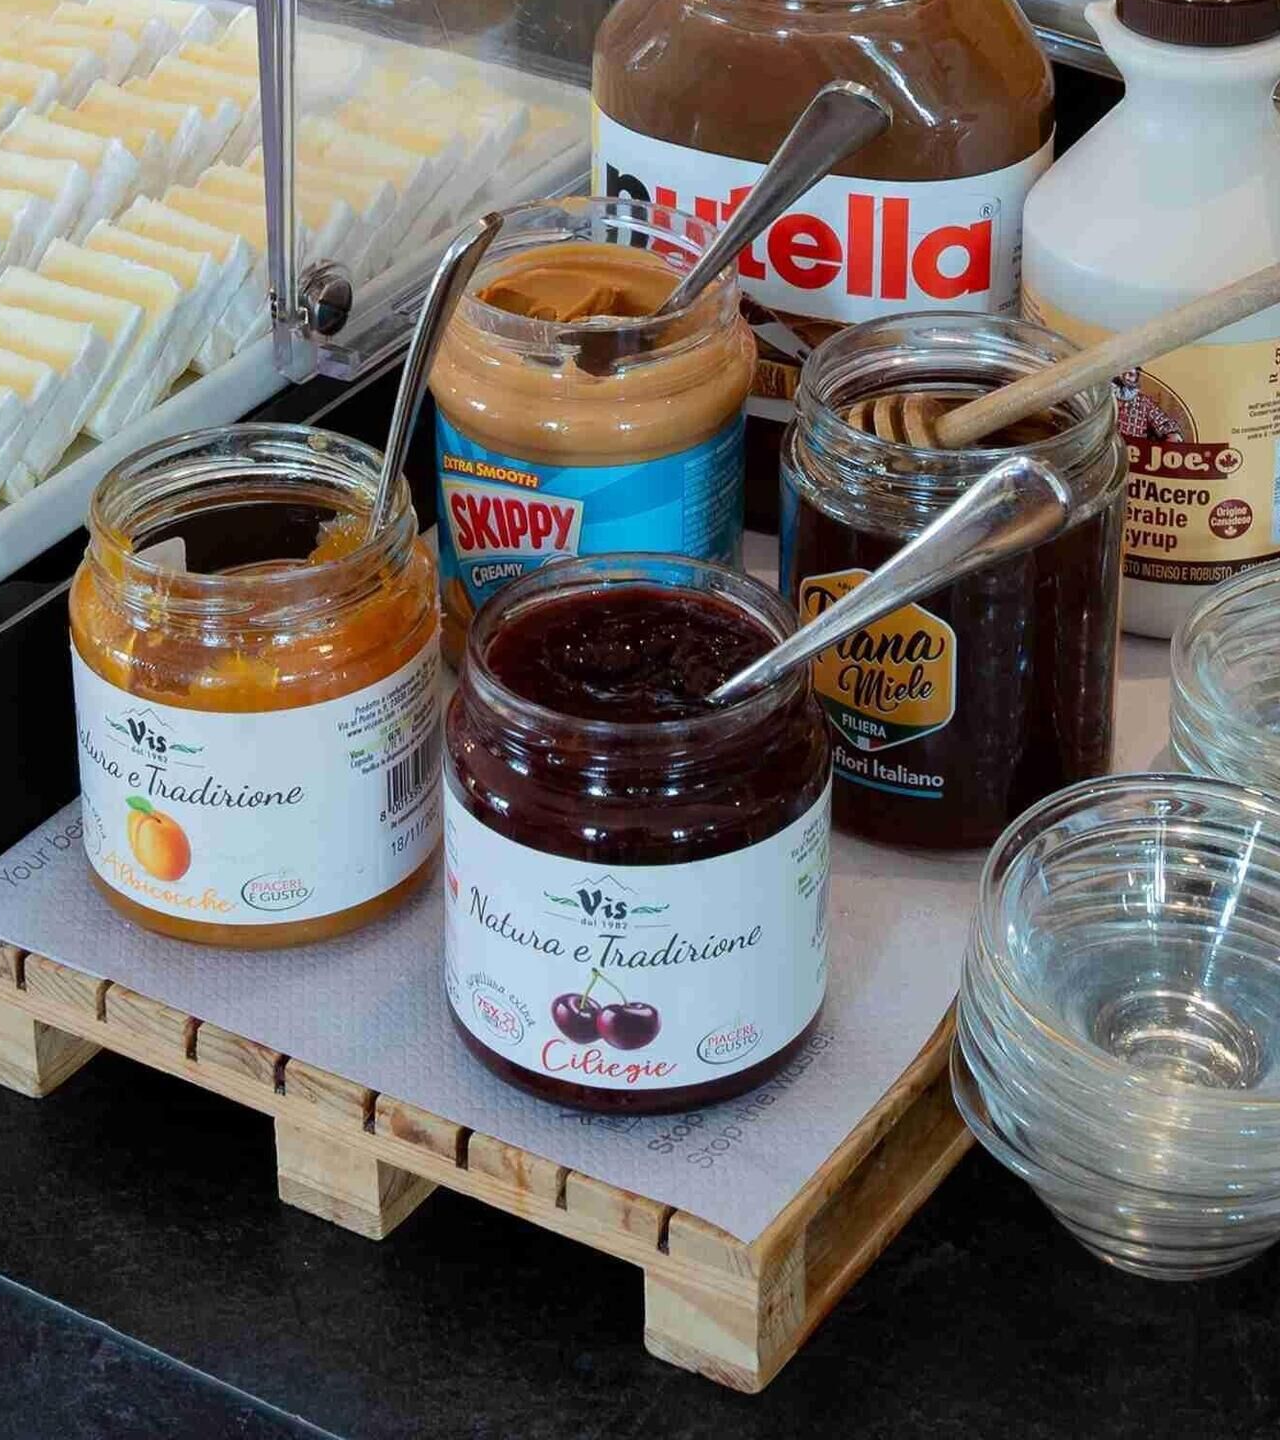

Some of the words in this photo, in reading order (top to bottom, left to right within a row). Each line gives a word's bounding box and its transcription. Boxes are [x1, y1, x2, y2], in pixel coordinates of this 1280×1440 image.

[444, 454, 473, 474] EXTRA
[474, 462, 539, 488] SMOOTH
[1145, 446, 1209, 471] Joe
[1128, 479, 1210, 505] d'Acero
[450, 492, 575, 551] SKIPPY
[472, 563, 522, 587] CREAMY
[1142, 564, 1180, 579] INTENSO
[1182, 568, 1188, 580] E
[1191, 567, 1232, 581] ROBUSTO
[838, 665, 932, 712] Miele
[126, 718, 167, 753] Vis
[841, 713, 887, 739] FILIERA
[832, 747, 868, 774] fiori
[873, 760, 944, 787] Italiano
[128, 770, 142, 788] e
[146, 763, 304, 809] Tradizione
[380, 810, 386, 822] 8
[250, 877, 305, 894] PIACERE
[258, 887, 308, 902] GUSTO
[576, 888, 627, 920] Vis
[470, 886, 565, 956] Natura
[573, 944, 592, 962] e
[597, 925, 763, 969] Tradizione
[708, 1023, 757, 1048] PIACERE
[715, 1032, 759, 1056] GUSTO
[541, 1038, 677, 1084] Ciliegie
[648, 1113, 706, 1156] Stop
[687, 1120, 741, 1170] Stop
[743, 1092, 777, 1129] the
